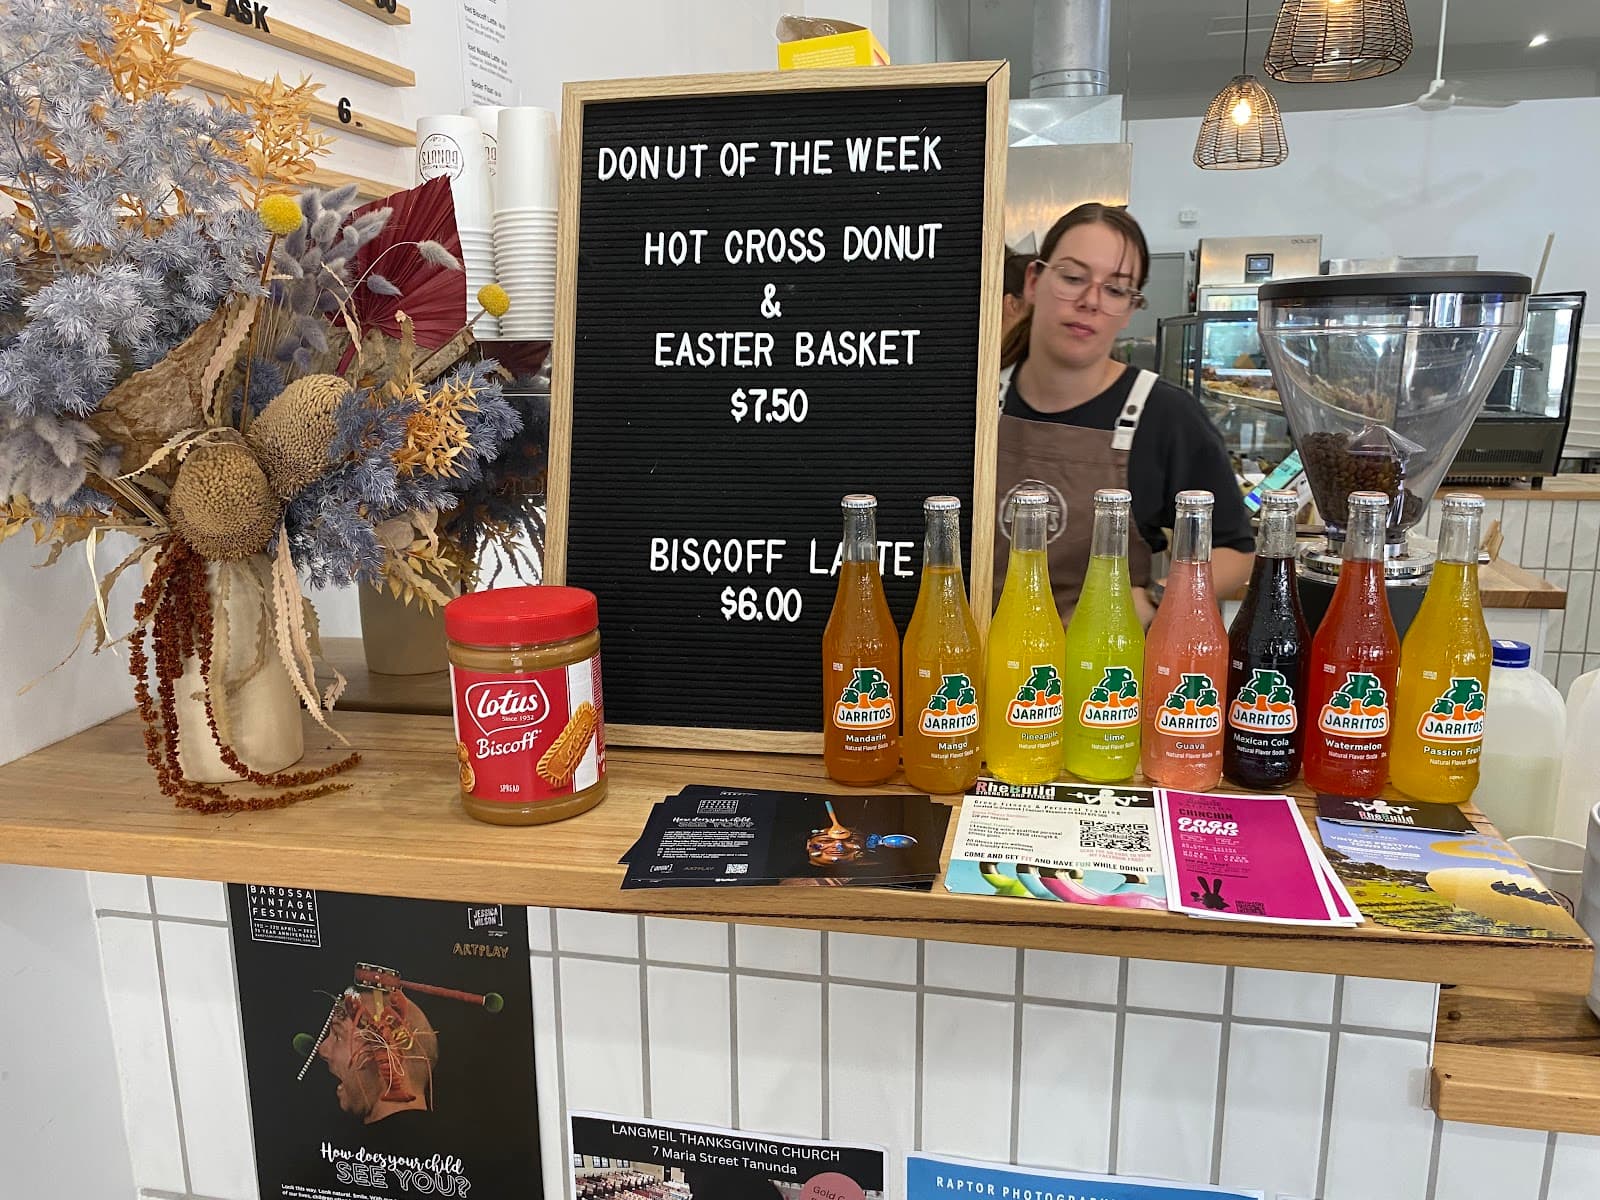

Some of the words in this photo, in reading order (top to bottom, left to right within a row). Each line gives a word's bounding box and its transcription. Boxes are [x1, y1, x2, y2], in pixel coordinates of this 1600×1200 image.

[421, 149, 458, 165] DONUTS
[598, 143, 709, 182] DONUT
[719, 141, 760, 177] OF
[771, 140, 834, 176] THE
[845, 135, 943, 173] WEEK
[644, 229, 709, 265] HOT
[724, 227, 826, 264] CROSS
[844, 223, 943, 262] DONUT
[760, 283, 782, 320] &
[654, 332, 774, 368] EASTER
[795, 330, 921, 367] BASKET
[730, 388, 809, 424] $7.50
[650, 538, 787, 576] BISCOFF
[720, 587, 803, 625] $6.00
[477, 688, 538, 718] Lotus
[839, 708, 891, 722] JARRITOS
[1013, 704, 1062, 720] JARRITOS
[1086, 707, 1138, 721] JARRITOS
[1234, 709, 1291, 725] JARRITOS
[925, 714, 976, 730] JARRITOS
[1162, 715, 1218, 729] JARRITOS
[1325, 715, 1384, 729] JARRITOS
[1425, 721, 1483, 734] JARRITOS
[846, 733, 886, 743] Mandarin
[1021, 731, 1058, 741] Pineapple
[1233, 733, 1268, 746] Mexican
[1271, 738, 1289, 746] Cola
[476, 730, 540, 759] Biscoff
[938, 742, 968, 751] Mango
[1176, 742, 1205, 750] Guava
[1236, 745, 1254, 754] Natural
[1325, 739, 1382, 750] Watermelon
[1423, 746, 1462, 756] Passion
[1328, 751, 1348, 759] Natural
[500, 784, 520, 793] SPREAD
[976, 782, 1055, 796] RheBuild
[1179, 809, 1232, 820] CHINCHIN
[1177, 817, 1238, 830] GOGO
[1179, 824, 1239, 836] LAWNS
[1375, 841, 1422, 850] FESTIVAL
[1094, 861, 1117, 869] WHILE
[1120, 864, 1144, 872] DOING
[250, 886, 312, 899] BAROSSA
[251, 896, 313, 910] VINTAGE
[253, 908, 314, 922] FESTIVAL
[473, 908, 498, 918] JESSICA
[474, 916, 496, 926] WILSON
[453, 943, 509, 958] ARTPLAY
[611, 1123, 677, 1143] LANGMEIL
[680, 1132, 778, 1156] THANKSGIVING
[781, 1145, 841, 1161] CHURCH
[320, 1142, 353, 1163] How
[355, 1146, 387, 1167] does
[386, 1155, 425, 1172] your
[425, 1154, 464, 1175] child
[651, 1146, 658, 1157] 7
[662, 1148, 697, 1162] Maria
[699, 1152, 739, 1167] Street
[741, 1157, 797, 1175] Tanunda
[336, 1162, 388, 1189] SEE
[394, 1168, 471, 1198] YOU?
[937, 1176, 995, 1196] RAPTOR
[813, 1186, 836, 1199] Gold
